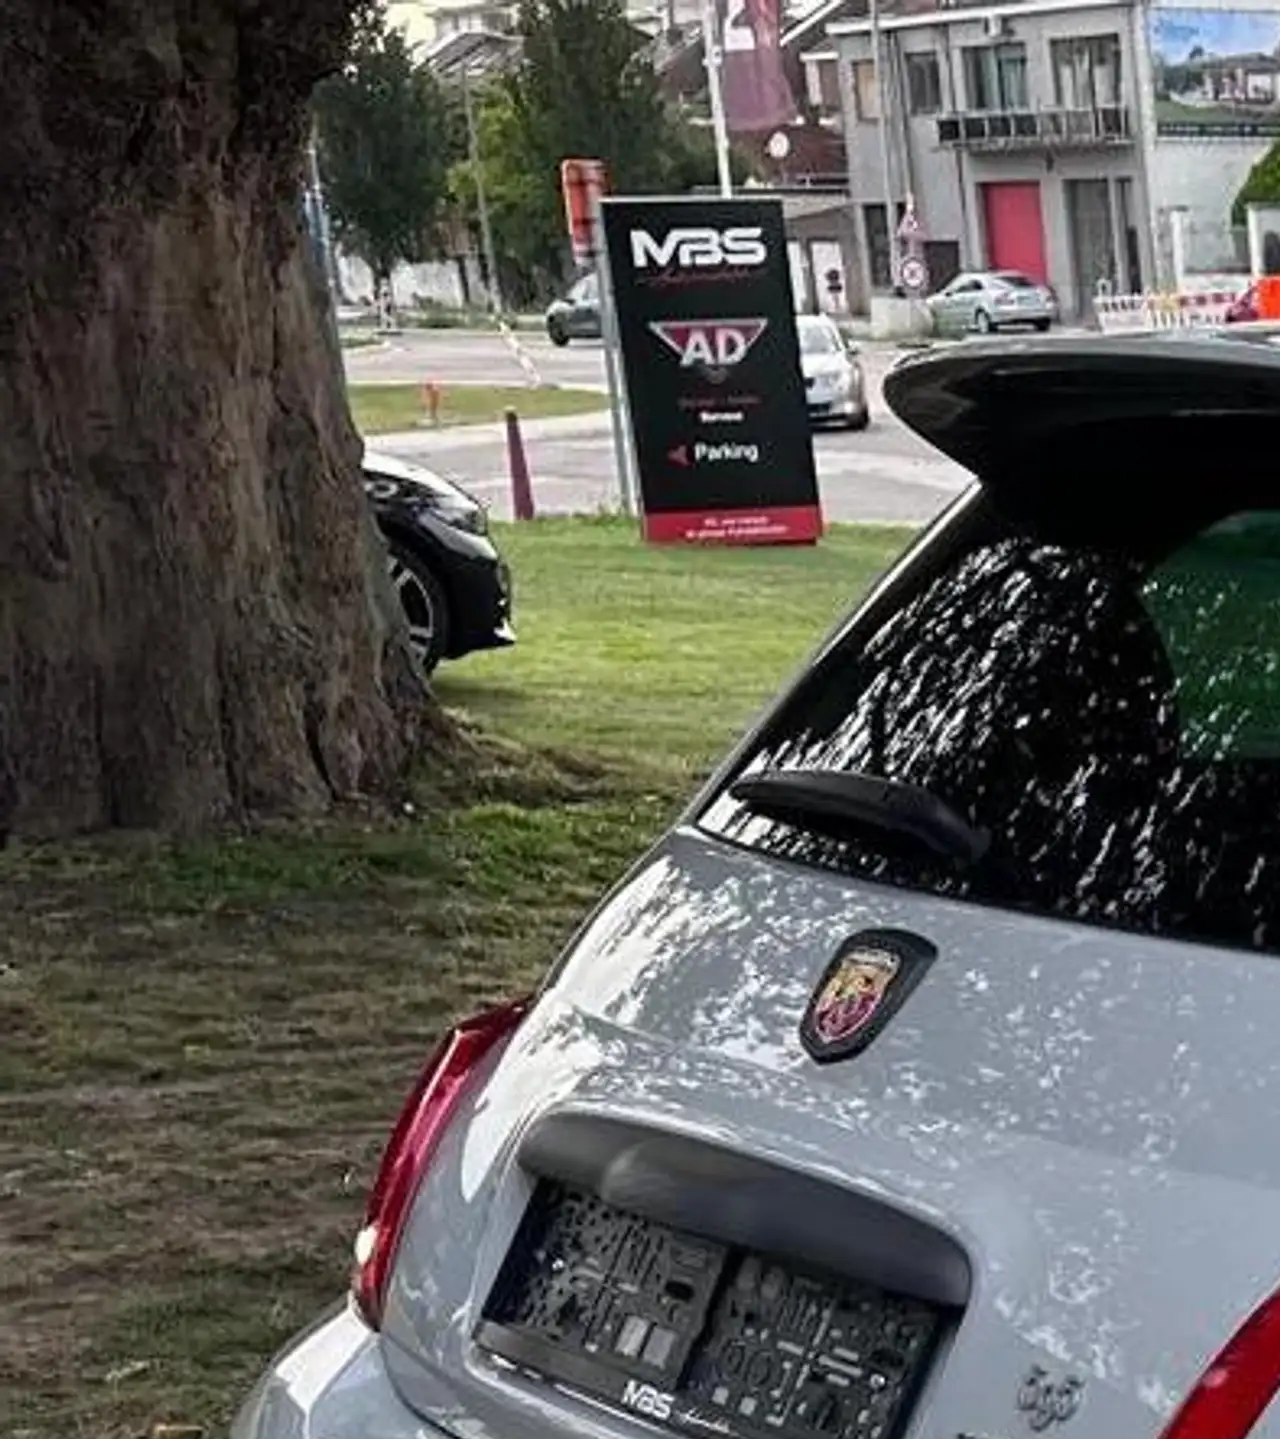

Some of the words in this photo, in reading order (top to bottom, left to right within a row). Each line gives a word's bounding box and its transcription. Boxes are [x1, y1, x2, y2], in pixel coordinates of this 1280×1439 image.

[630, 226, 768, 268] MBS
[679, 327, 748, 367] AD
[694, 443, 759, 463] Parking
[621, 1379, 676, 1420] MBS
